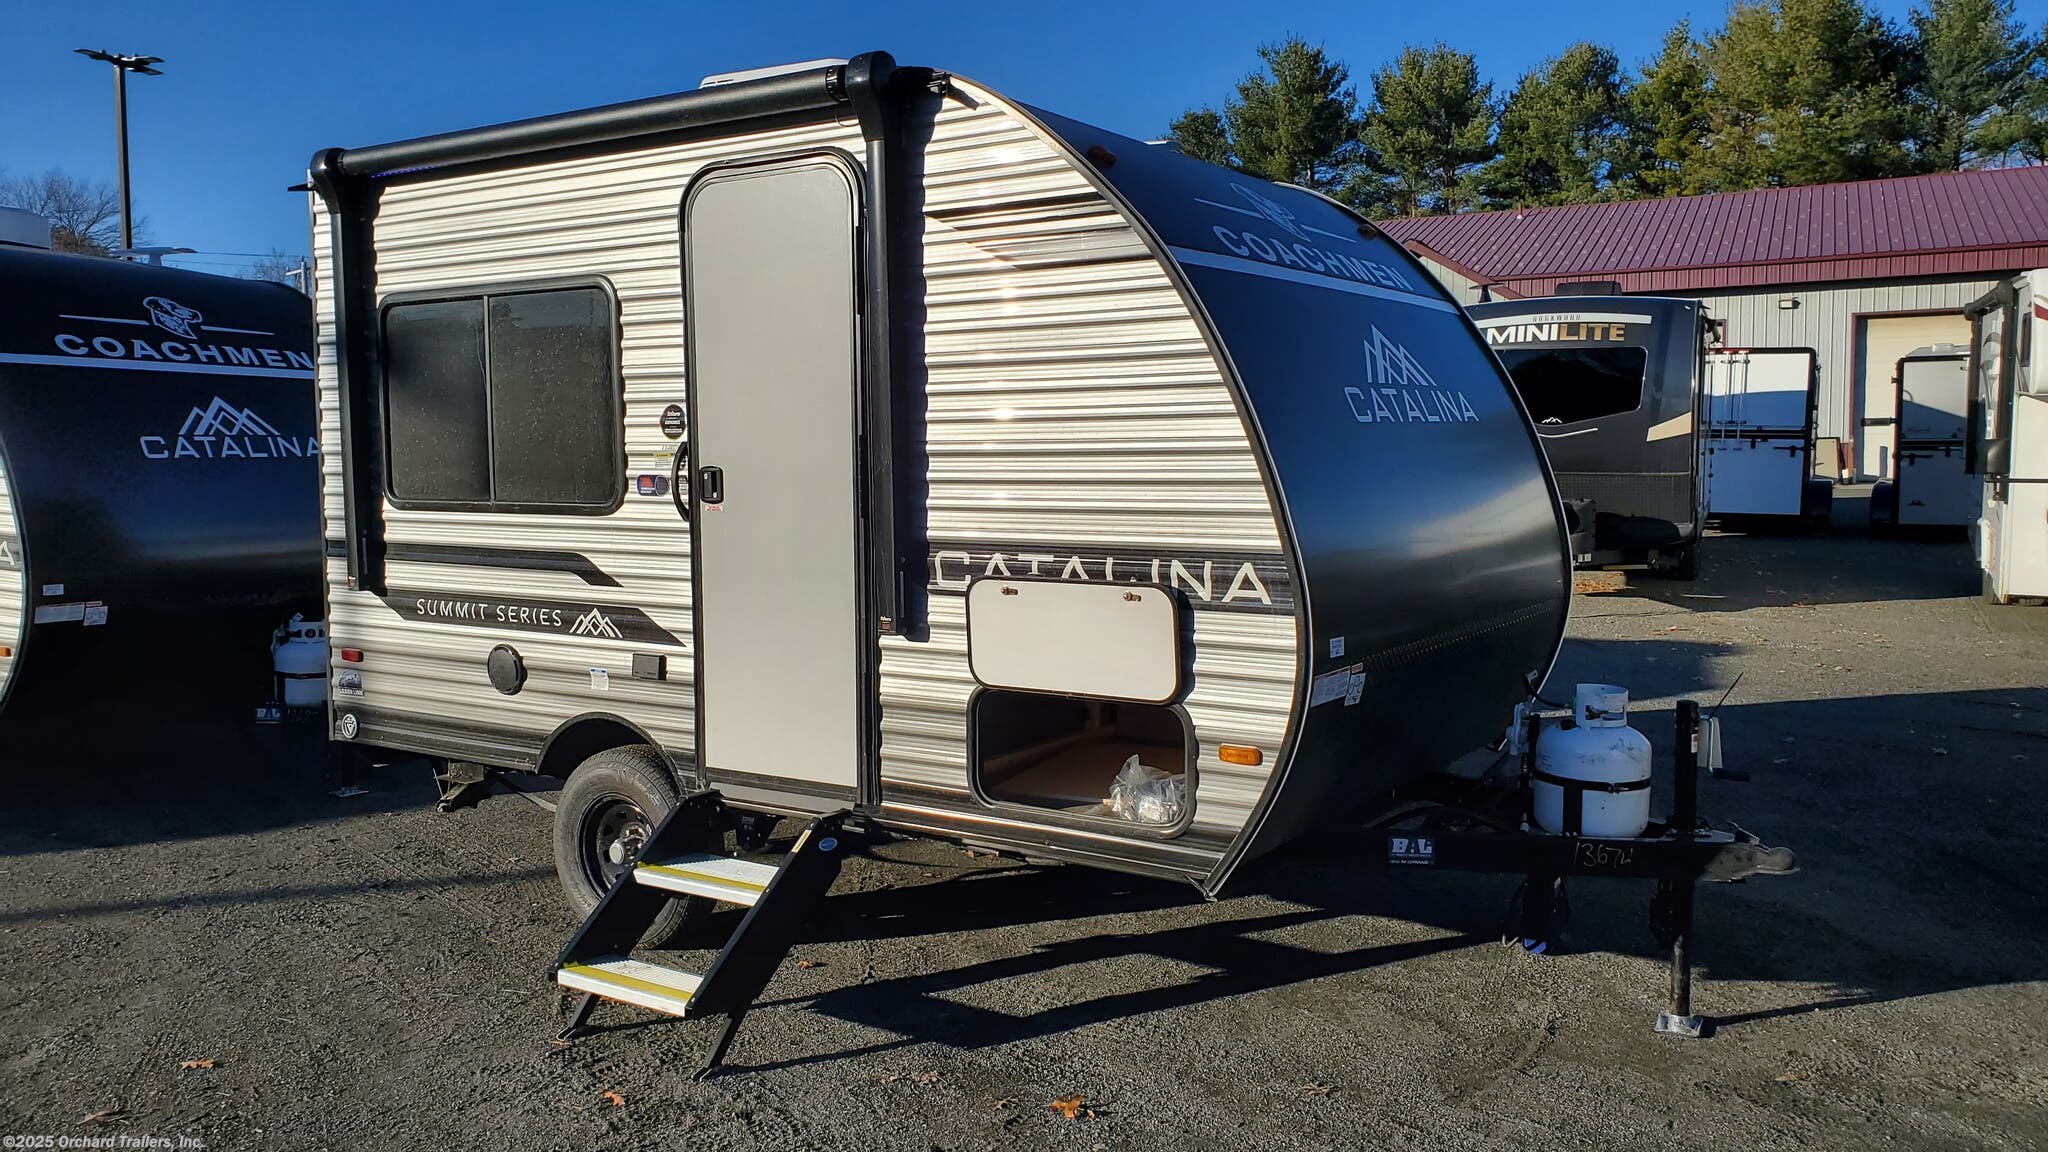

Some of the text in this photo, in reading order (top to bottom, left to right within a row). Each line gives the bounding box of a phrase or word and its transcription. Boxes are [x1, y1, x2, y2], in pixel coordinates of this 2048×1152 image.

[1212, 225, 1414, 291] COACHMEN
[53, 333, 315, 369] COACHMEN
[1343, 386, 1480, 423] CATALINA
[416, 598, 562, 627] SUMMIT SERIES
